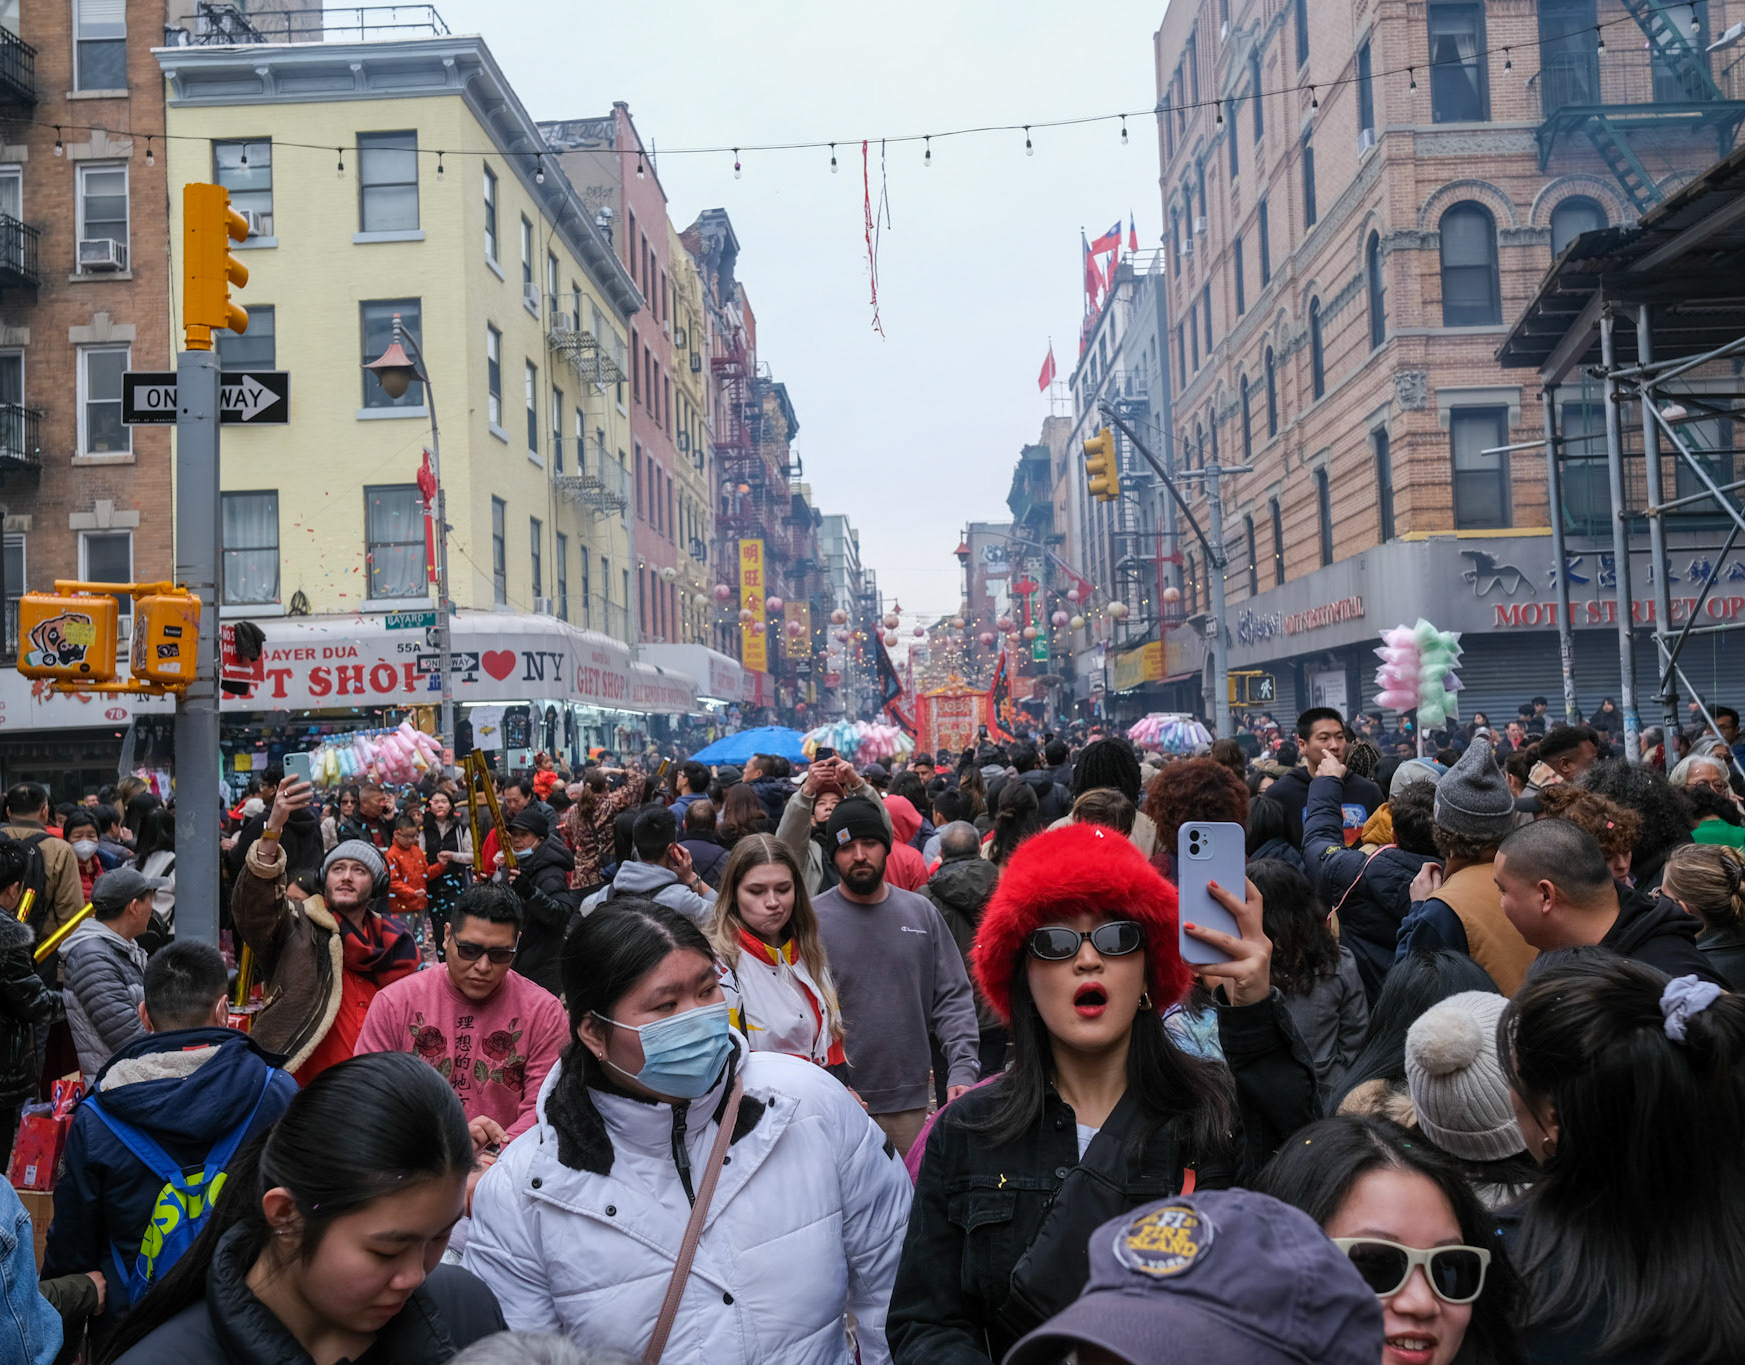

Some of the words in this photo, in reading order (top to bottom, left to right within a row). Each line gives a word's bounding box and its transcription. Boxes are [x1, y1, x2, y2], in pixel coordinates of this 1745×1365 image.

[147, 388, 177, 408] ON
[220, 388, 264, 408] WAY
[387, 612, 424, 626] BAYARD
[1492, 601, 1582, 628] MOTT
[264, 648, 316, 661] AYER
[323, 646, 358, 659] DUA
[397, 643, 421, 653] 55A
[425, 659, 440, 667] ON
[451, 658, 470, 667] WAY
[522, 651, 565, 682] NY
[577, 665, 600, 697] GIFT
[602, 670, 625, 700] SHOP
[109, 709, 123, 719] 78
